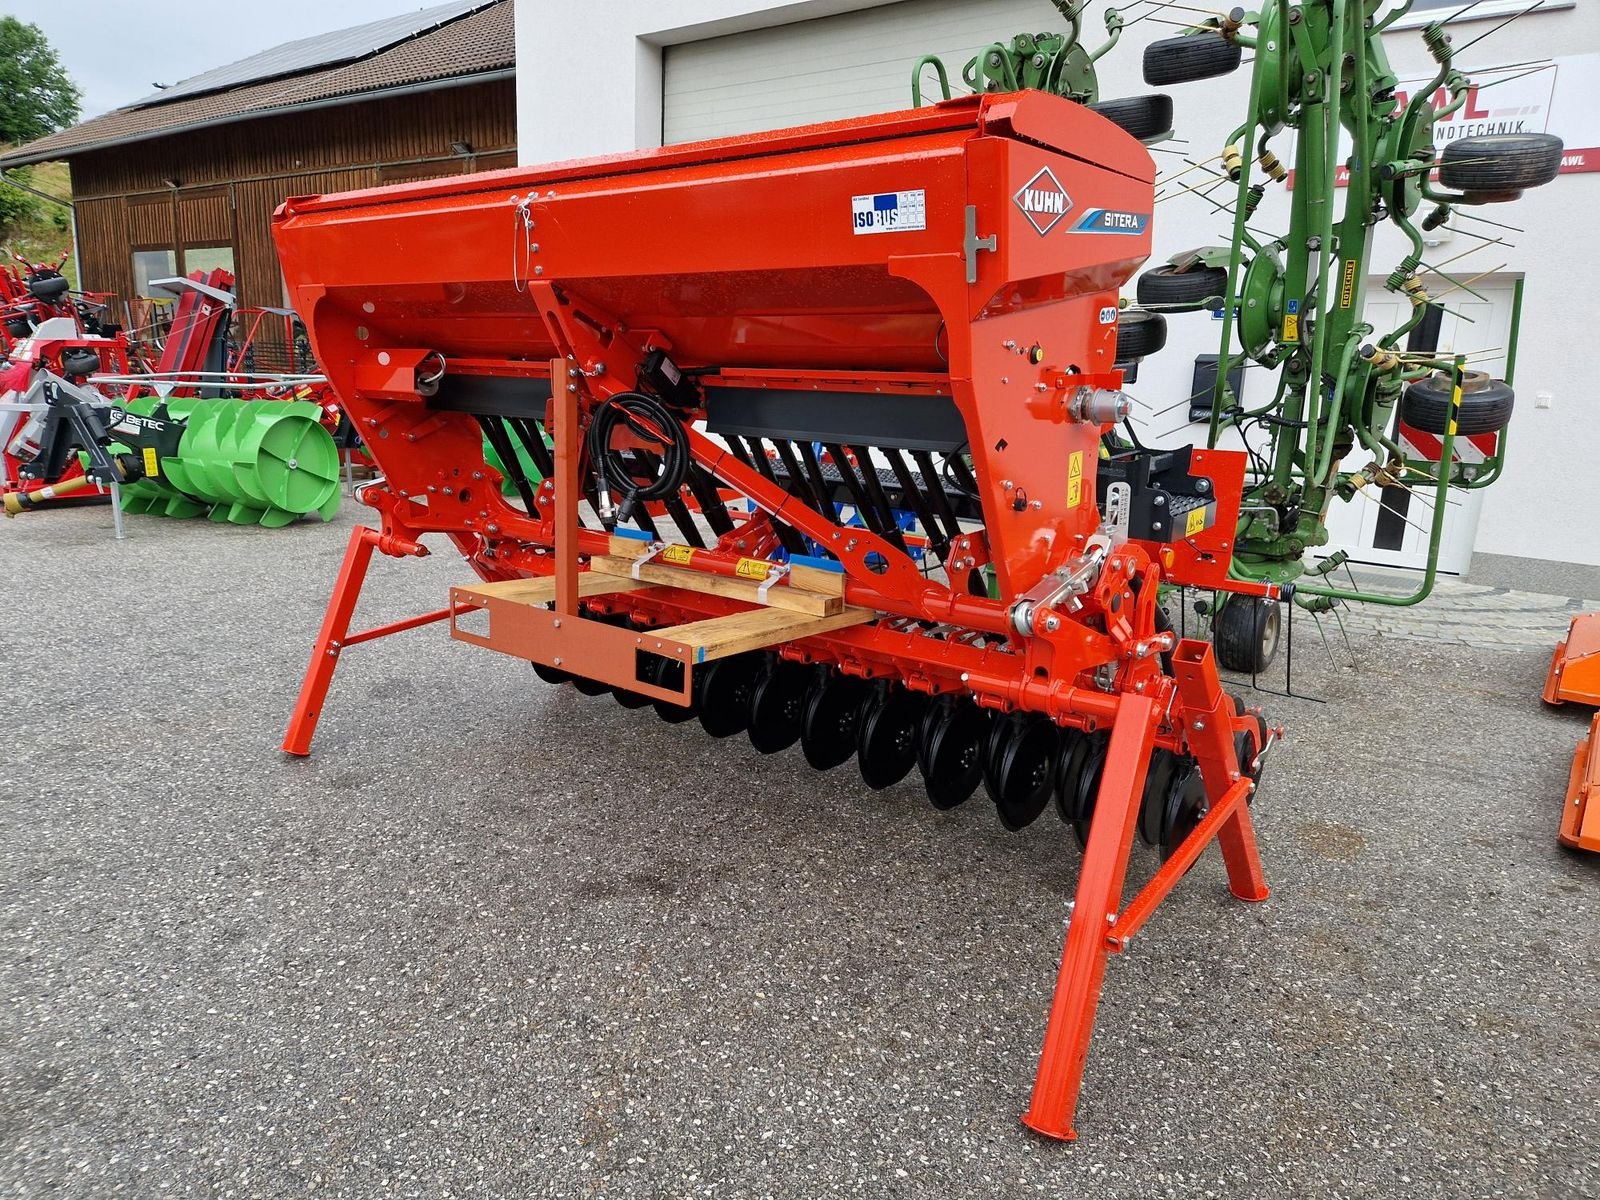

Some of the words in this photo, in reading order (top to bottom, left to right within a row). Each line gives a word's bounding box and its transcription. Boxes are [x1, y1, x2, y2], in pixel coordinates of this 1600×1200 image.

[1437, 120, 1524, 139] NDTECHNIK
[1024, 189, 1064, 213] KUHN
[1104, 212, 1138, 228] SITERA
